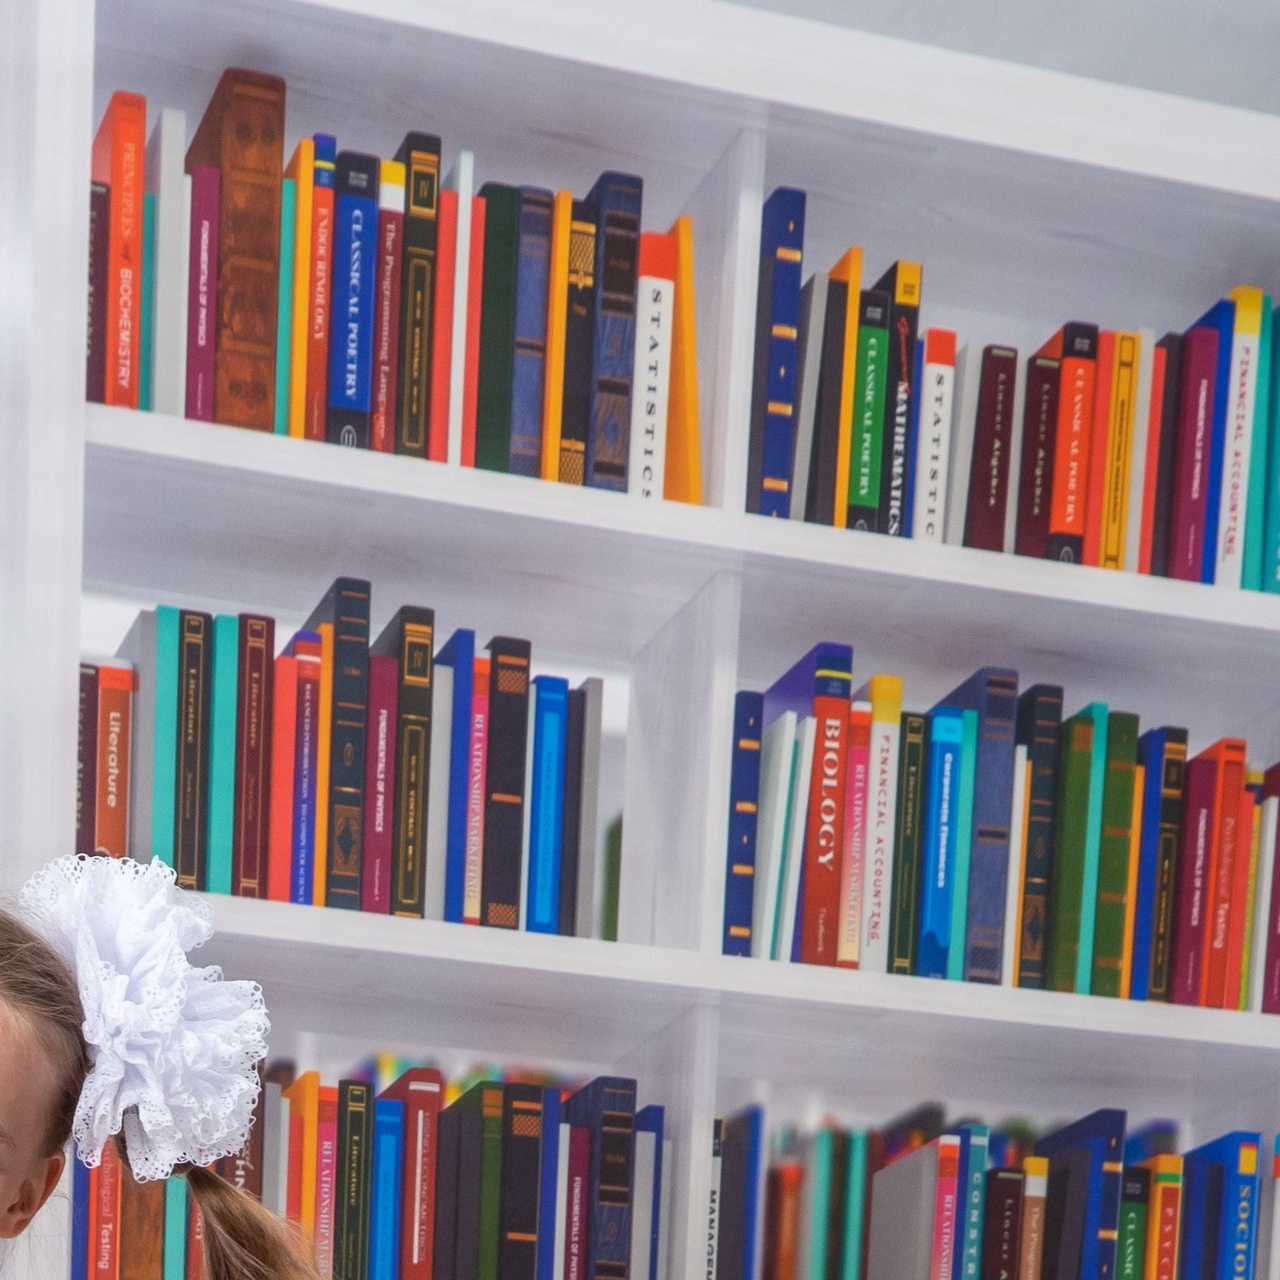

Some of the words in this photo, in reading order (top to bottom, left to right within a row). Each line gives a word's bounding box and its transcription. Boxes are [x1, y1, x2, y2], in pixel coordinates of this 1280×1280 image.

[122, 142, 137, 237] PRINCIPLES
[347, 208, 363, 318] CLASSICAL
[385, 219, 396, 251] The
[118, 267, 133, 389] BIOCHEMISTRY
[379, 255, 395, 361] Programming
[345, 321, 359, 400] POETRY
[863, 336, 878, 426] CLASSICAL
[1233, 346, 1252, 443] FINANCIAL
[995, 373, 1007, 432] Linear
[1069, 367, 1085, 457] CLASSICAL
[859, 431, 874, 499] POETRY
[888, 379, 910, 537] MATHEMATICS
[989, 437, 1003, 507] Algebra
[1032, 448, 1047, 517] Algebra
[1223, 450, 1242, 558] ACCOUNTING
[186, 667, 198, 744] Literature
[249, 672, 260, 749] Literature
[377, 708, 388, 780] FUNDAMENTALS
[106, 710, 122, 808] Literature
[377, 780, 386, 793] OF
[470, 713, 486, 814] RELATIONSHIP
[818, 716, 841, 872] BIOLOGY
[875, 734, 891, 828] FINANCIAL
[940, 752, 954, 824] Corporate
[375, 794, 385, 833] PHYSICS
[850, 764, 866, 861] RELATIONSHIP
[466, 815, 482, 900] MARKETING
[868, 836, 885, 941] ACCOUNTING
[1213, 902, 1229, 949] Testing
[319, 1140, 334, 1237] RELATIONSHIP
[349, 1134, 361, 1206] Literature
[571, 1176, 582, 1242] FUNDAMENTALS
[98, 1222, 113, 1270] Testing
[570, 1243, 580, 1254] OF
[1001, 1198, 1014, 1261] Linear
[1029, 1206, 1041, 1230] The
